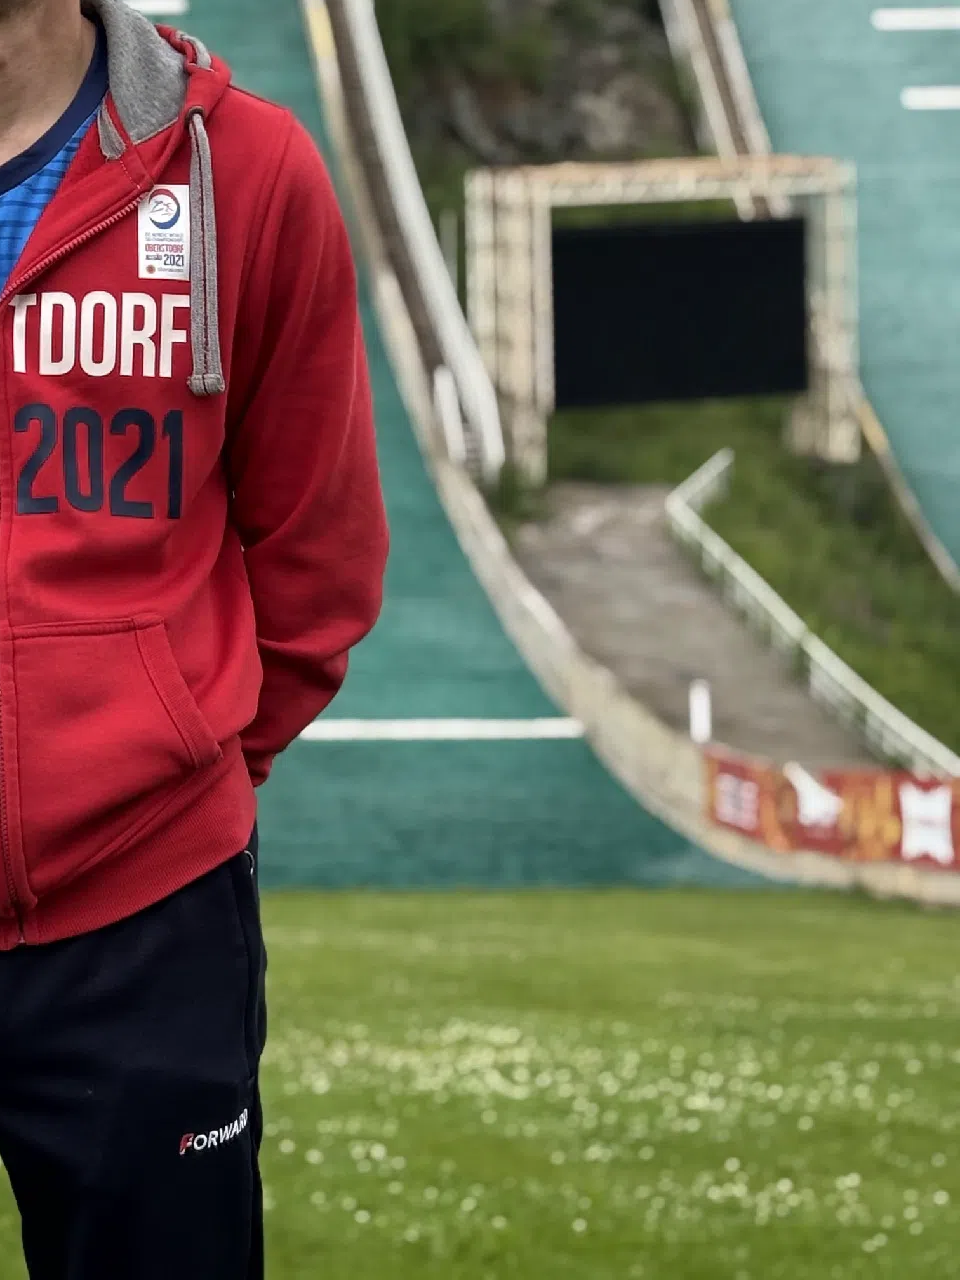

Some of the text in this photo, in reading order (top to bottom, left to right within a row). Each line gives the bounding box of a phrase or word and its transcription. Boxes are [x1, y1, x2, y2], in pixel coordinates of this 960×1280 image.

[163, 254, 184, 266] 2021
[14, 403, 184, 519] 2021
[179, 1108, 248, 1155] FORWARD
